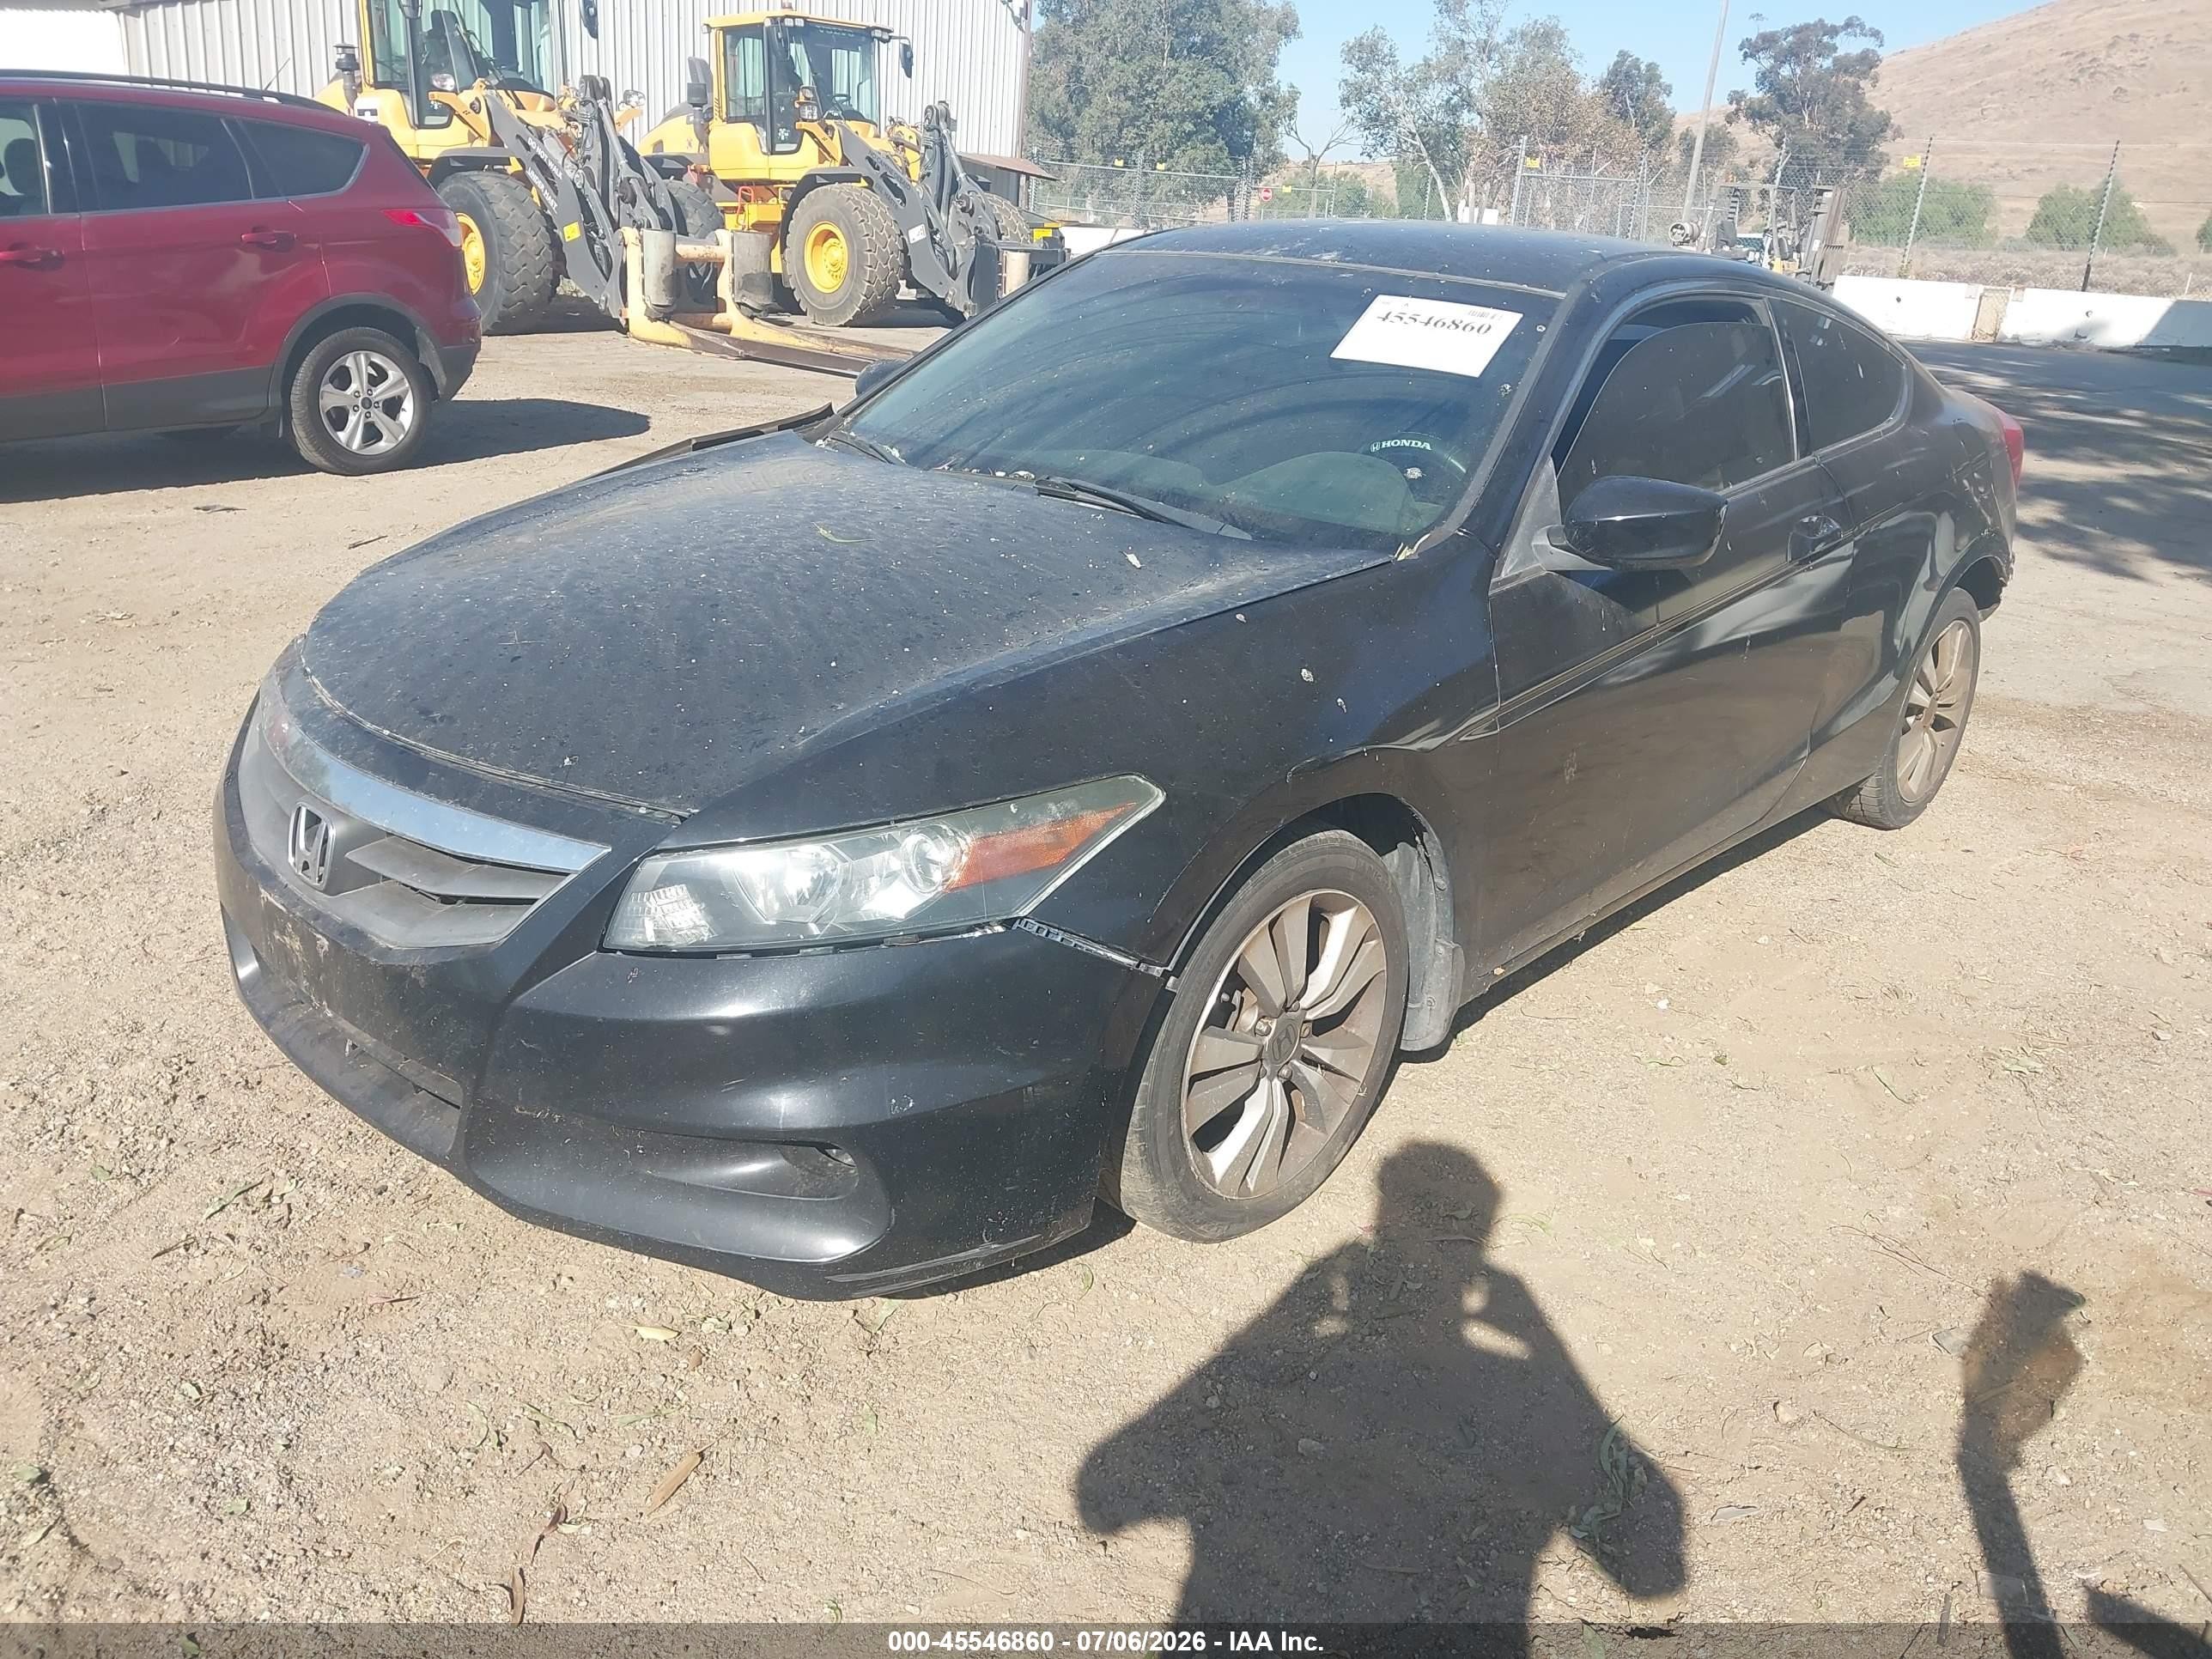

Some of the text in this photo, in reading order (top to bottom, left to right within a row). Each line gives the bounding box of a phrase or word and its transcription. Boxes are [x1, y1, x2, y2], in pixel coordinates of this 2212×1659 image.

[528, 137, 562, 180] DO NOT WALK
[526, 167, 557, 214] UNDER MAST
[1376, 311, 1492, 335] 45546860
[1382, 439, 1432, 451] HONDA
